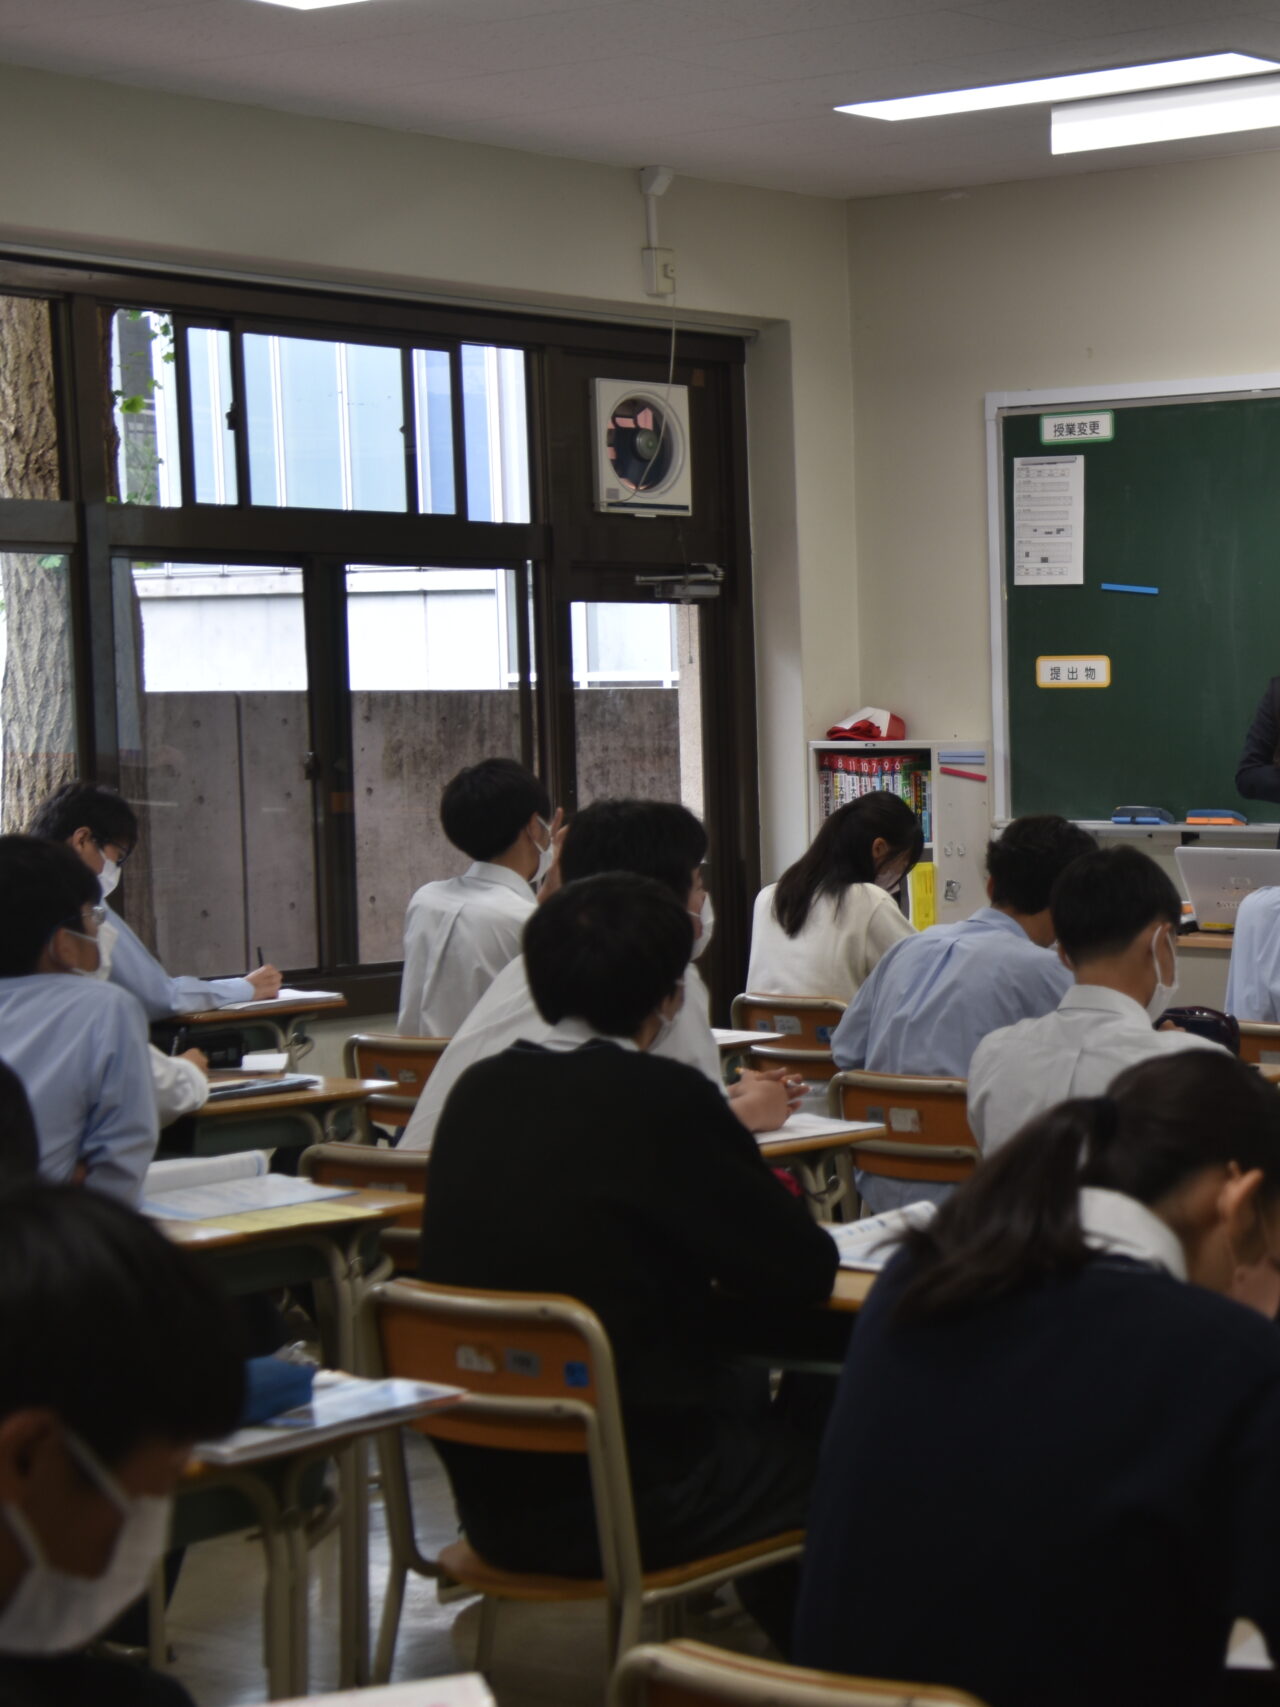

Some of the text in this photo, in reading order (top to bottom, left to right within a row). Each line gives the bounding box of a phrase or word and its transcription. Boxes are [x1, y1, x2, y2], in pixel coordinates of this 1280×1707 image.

[1053, 420, 1101, 437] 授業変更
[1050, 666, 1096, 681] 提出物
[837, 758, 843, 768] 8
[848, 761, 856, 771] 11
[861, 762, 869, 772] 10
[872, 762, 877, 772] 7
[883, 761, 889, 771] 9
[894, 760, 900, 770] 6
